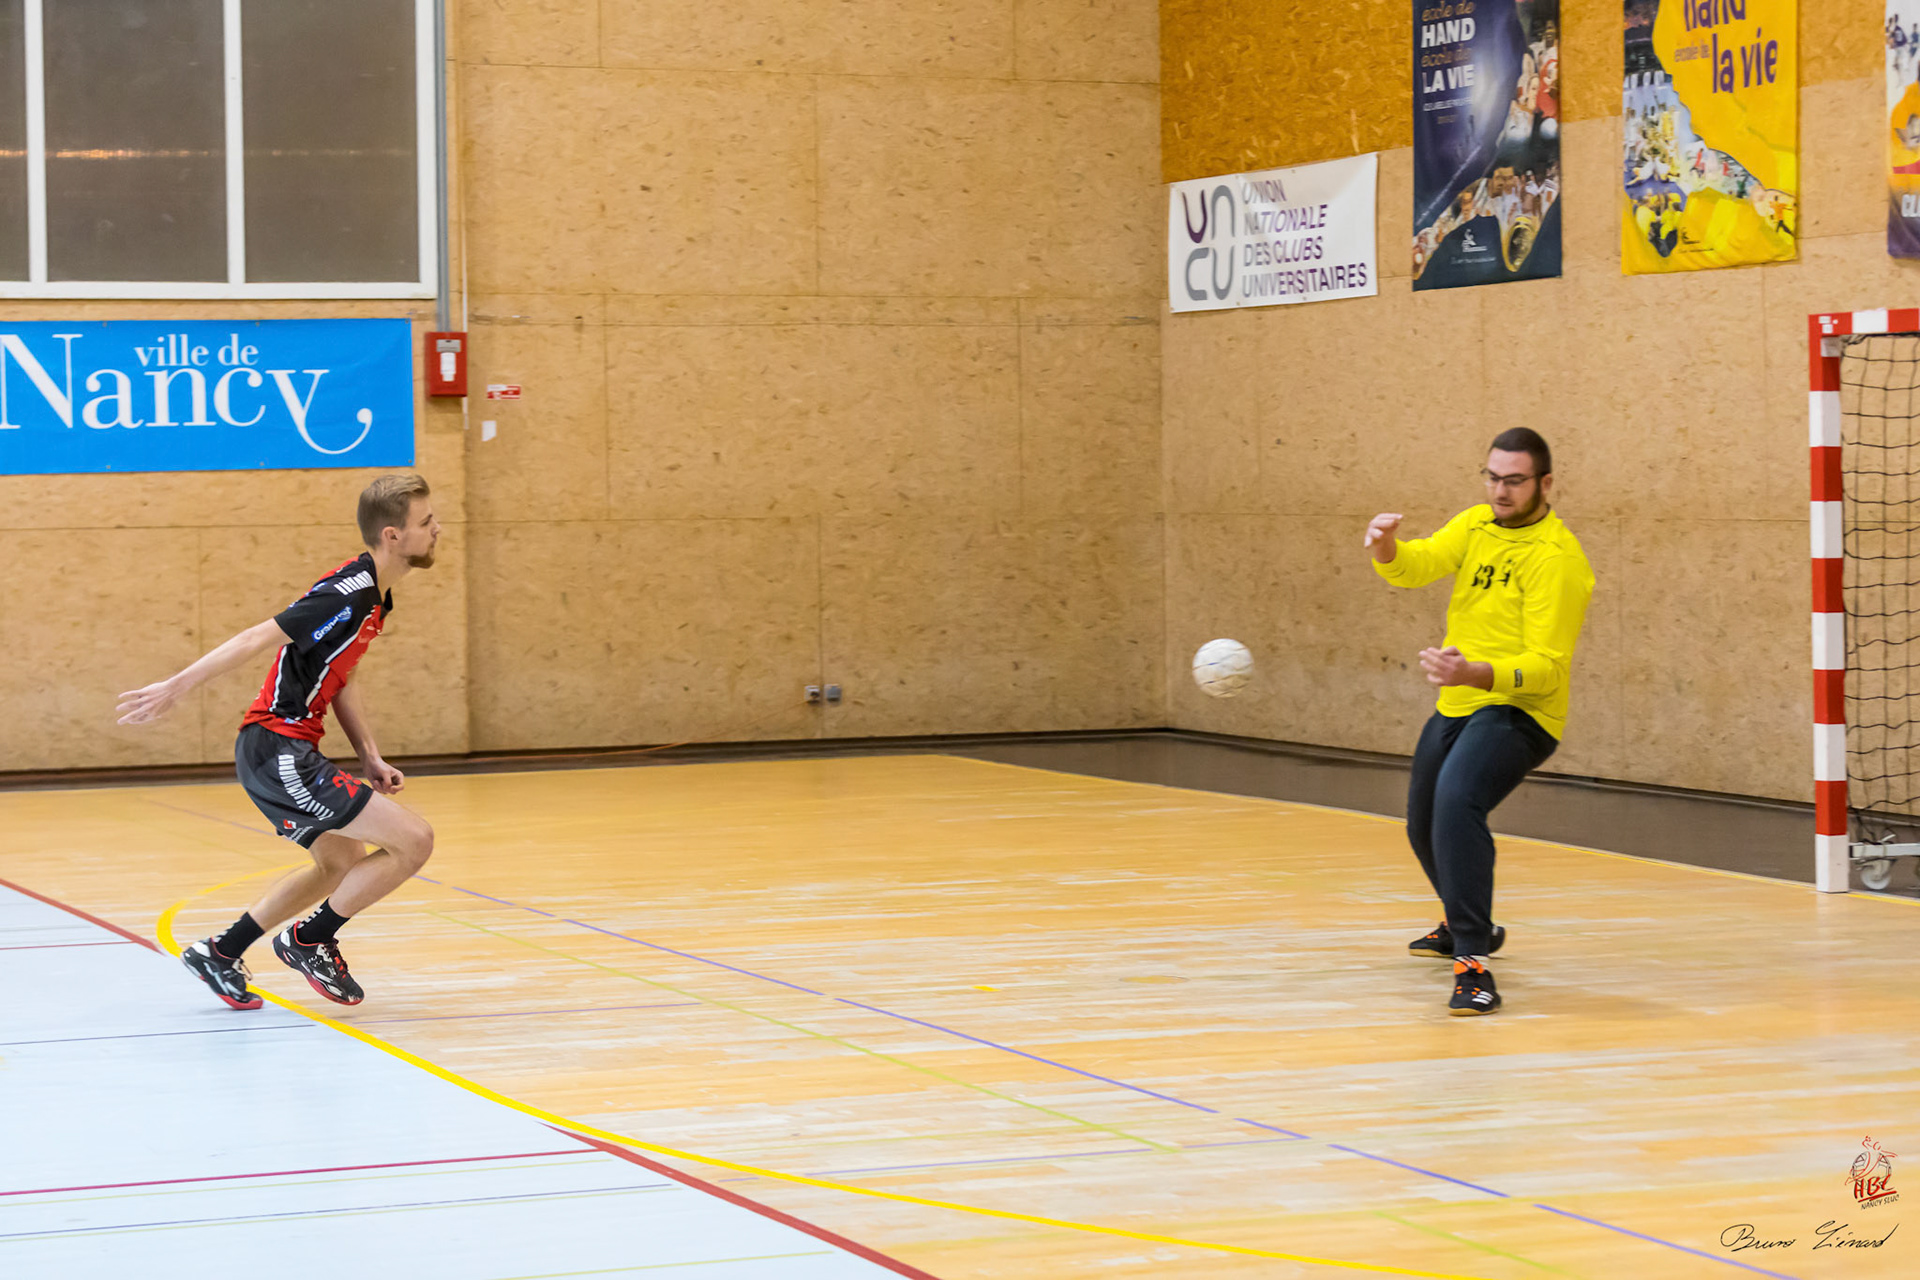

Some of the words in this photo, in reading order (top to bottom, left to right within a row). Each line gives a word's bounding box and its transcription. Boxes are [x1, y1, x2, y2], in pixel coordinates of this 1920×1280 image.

[1421, 17, 1476, 48] HAND
[1712, 33, 1734, 93] la
[1741, 27, 1777, 88] vie
[1422, 70, 1445, 93] LA
[1447, 64, 1475, 90] VIE
[1242, 180, 1286, 204] UNION
[1244, 204, 1328, 235] NATIONALE
[1244, 242, 1271, 267] DES
[1273, 236, 1323, 264] CLUBS
[1242, 263, 1367, 298] UNIVERSITAIRES
[134, 333, 209, 367] ville
[217, 333, 259, 366] de
[0, 333, 373, 455] Nancy
